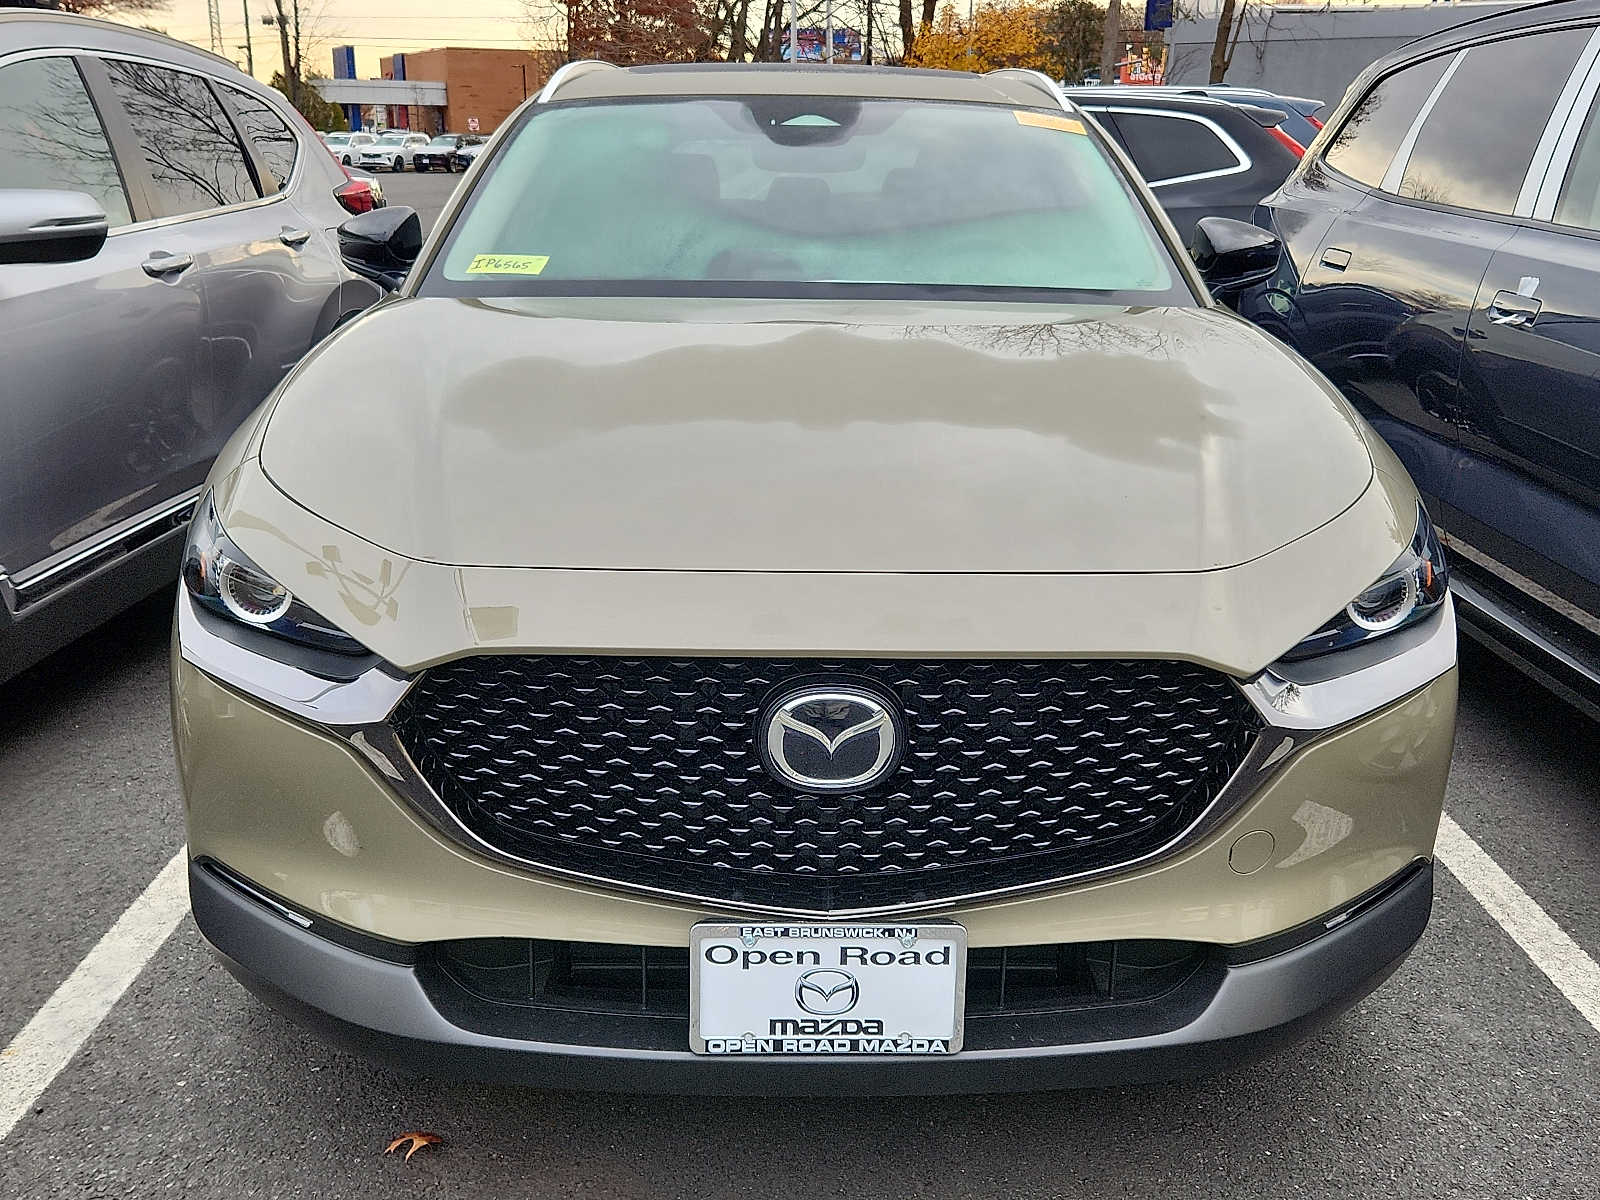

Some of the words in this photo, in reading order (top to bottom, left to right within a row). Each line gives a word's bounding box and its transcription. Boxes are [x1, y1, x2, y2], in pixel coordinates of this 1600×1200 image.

[742, 927, 784, 937] EAST
[895, 928, 916, 938] NJ
[705, 945, 820, 969] Open
[840, 946, 950, 965] Road
[769, 1018, 884, 1036] mazda
[707, 1039, 774, 1053] OPEN
[784, 1039, 850, 1053] ROAD
[858, 1039, 947, 1053] MAZDA
